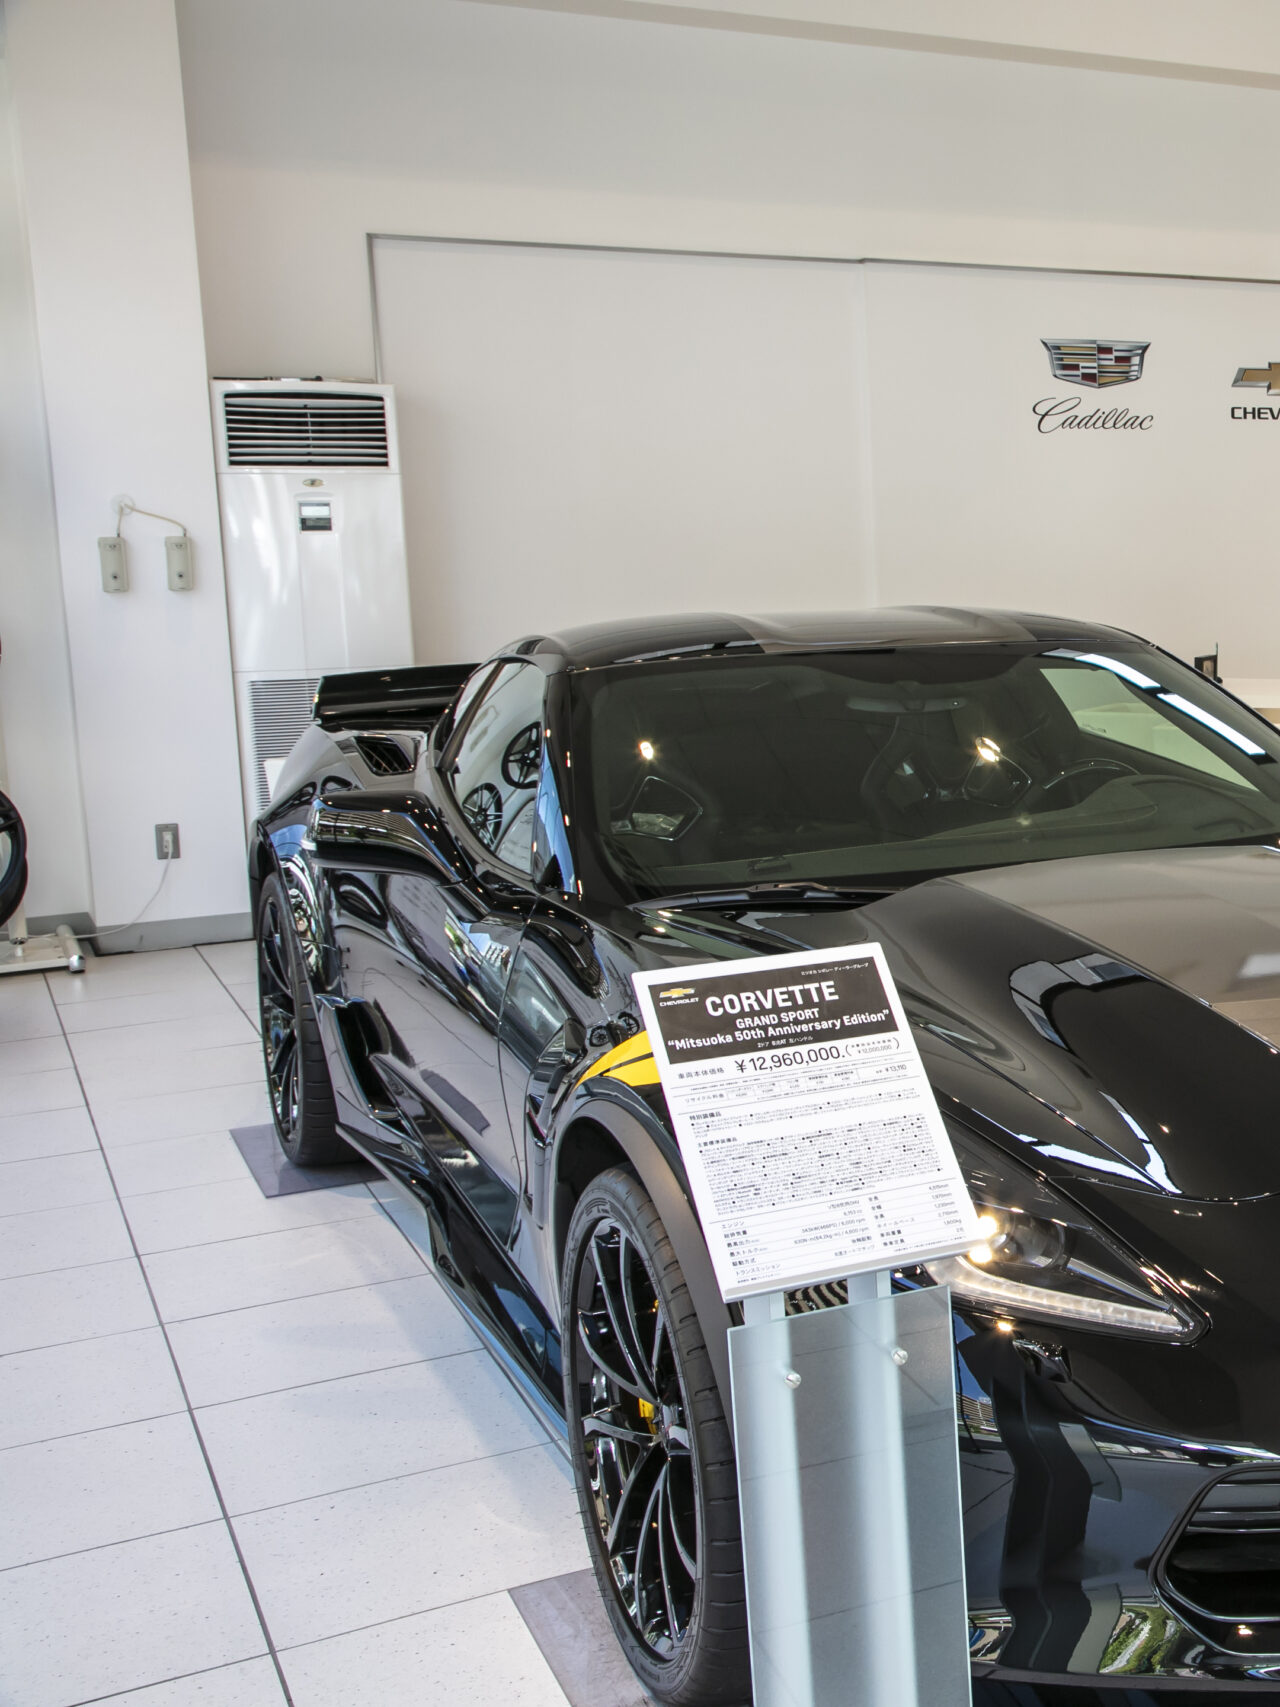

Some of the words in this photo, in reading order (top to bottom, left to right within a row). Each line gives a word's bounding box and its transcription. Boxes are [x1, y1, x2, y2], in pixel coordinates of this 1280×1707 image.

[1032, 396, 1154, 434] Cadillac
[659, 997, 699, 1007] CHEVROLET
[705, 980, 840, 1017] CORVETTE
[734, 1028, 766, 1042] 50th
[767, 1018, 841, 1037] Anniversary
[735, 1014, 779, 1029] GRAND
[781, 1008, 820, 1023] SPORT
